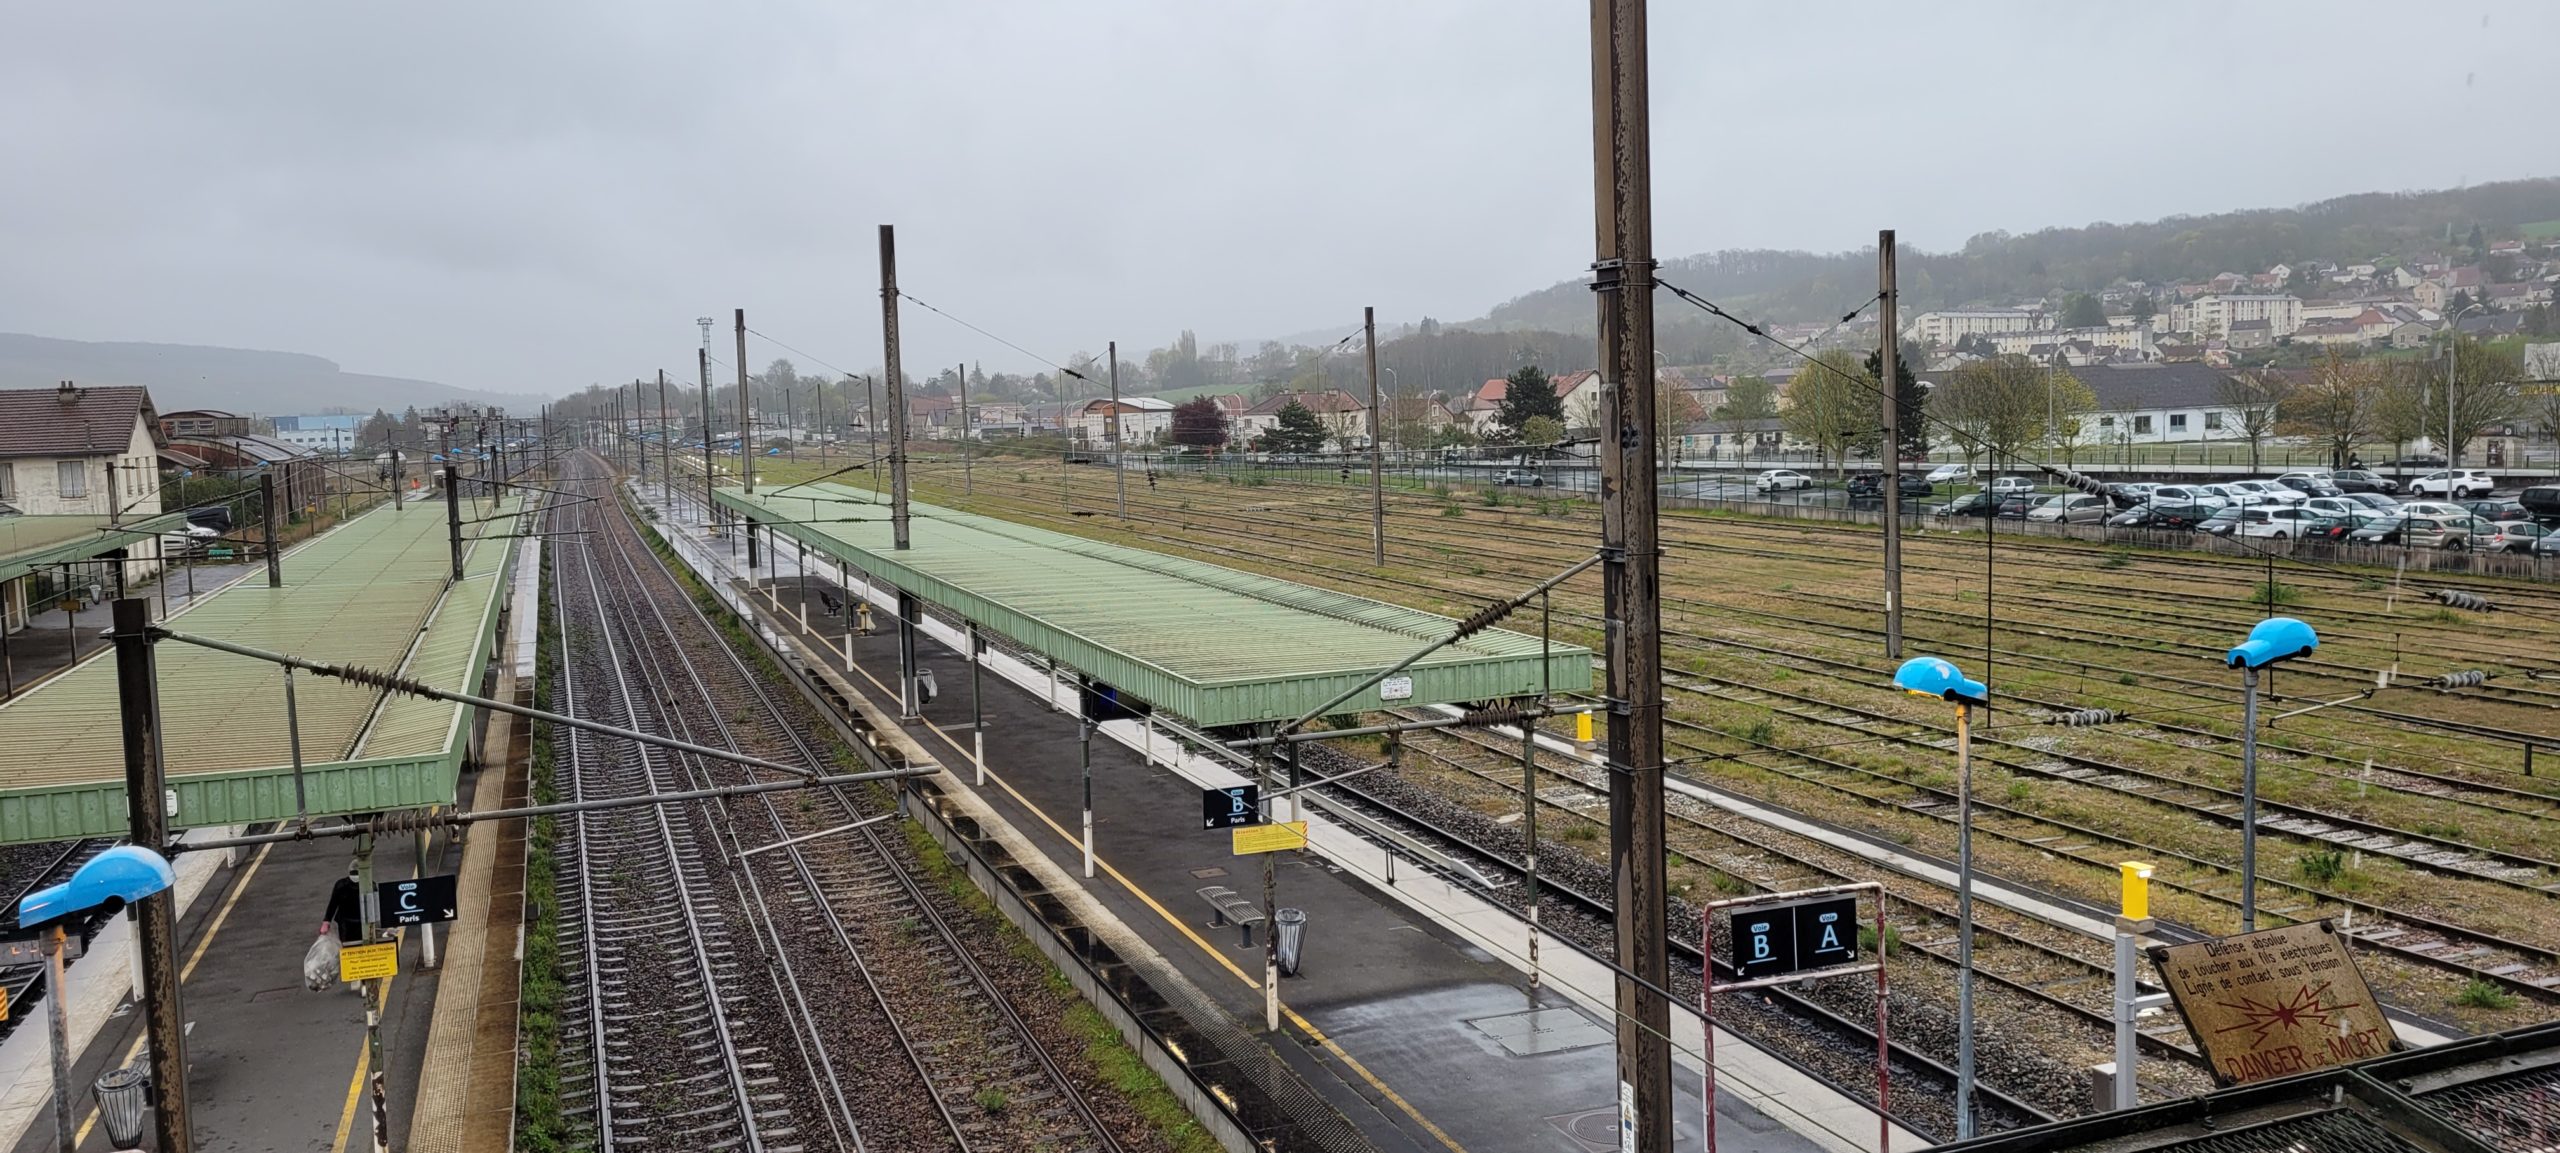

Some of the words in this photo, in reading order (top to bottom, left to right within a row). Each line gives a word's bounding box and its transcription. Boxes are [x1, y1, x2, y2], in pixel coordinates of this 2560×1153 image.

[1232, 796, 1244, 812] B
[400, 892, 417, 910] C
[400, 915, 420, 923] Paris
[1754, 934, 1770, 958] B
[1821, 924, 1839, 948] A
[2252, 934, 2288, 950] absolue
[2178, 967, 2190, 980] de
[2195, 961, 2231, 977] toucher
[2239, 958, 2255, 969] aux
[2259, 951, 2276, 965] fils
[2183, 981, 2215, 997] Ligne
[2220, 977, 2232, 990] de
[2237, 969, 2275, 986] contact
[2279, 966, 2302, 978] sous
[2304, 957, 2342, 974] tension
[2225, 1045, 2310, 1081] DANGER
[2313, 1053, 2326, 1066] DE
[2326, 1029, 2386, 1062] MORT
